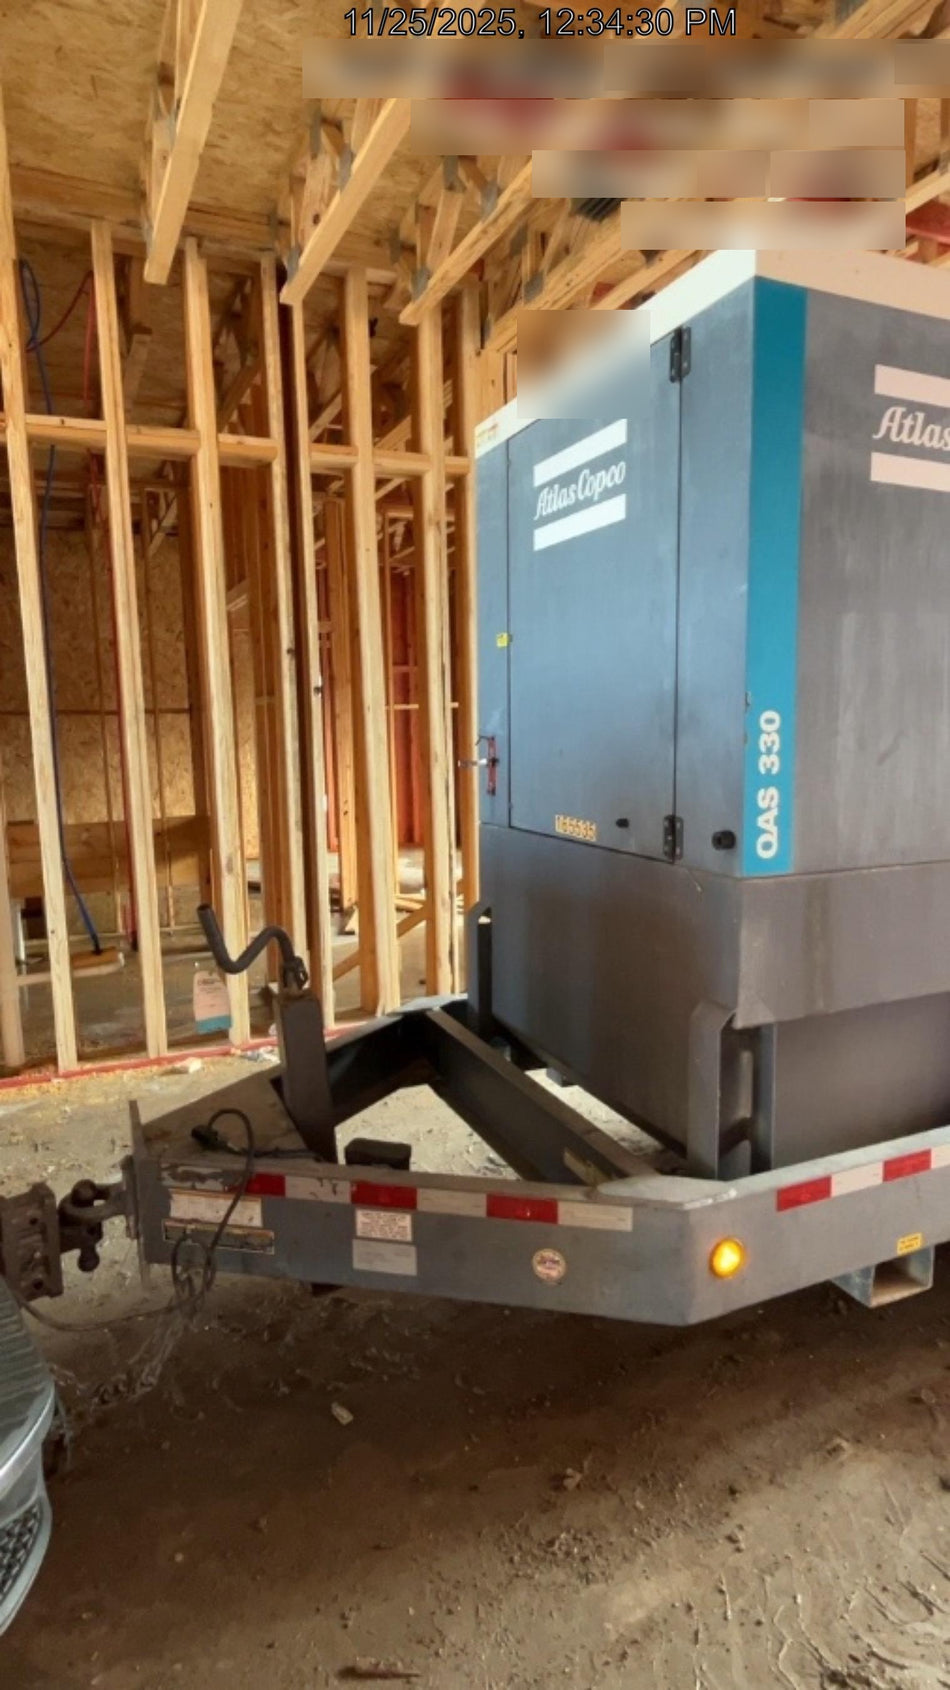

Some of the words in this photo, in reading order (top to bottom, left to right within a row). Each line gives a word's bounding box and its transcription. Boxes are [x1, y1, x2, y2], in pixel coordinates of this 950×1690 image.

[533, 483, 577, 521] Atlas
[577, 461, 626, 502] Copco
[758, 710, 781, 775] 330
[756, 786, 779, 860] QAS
